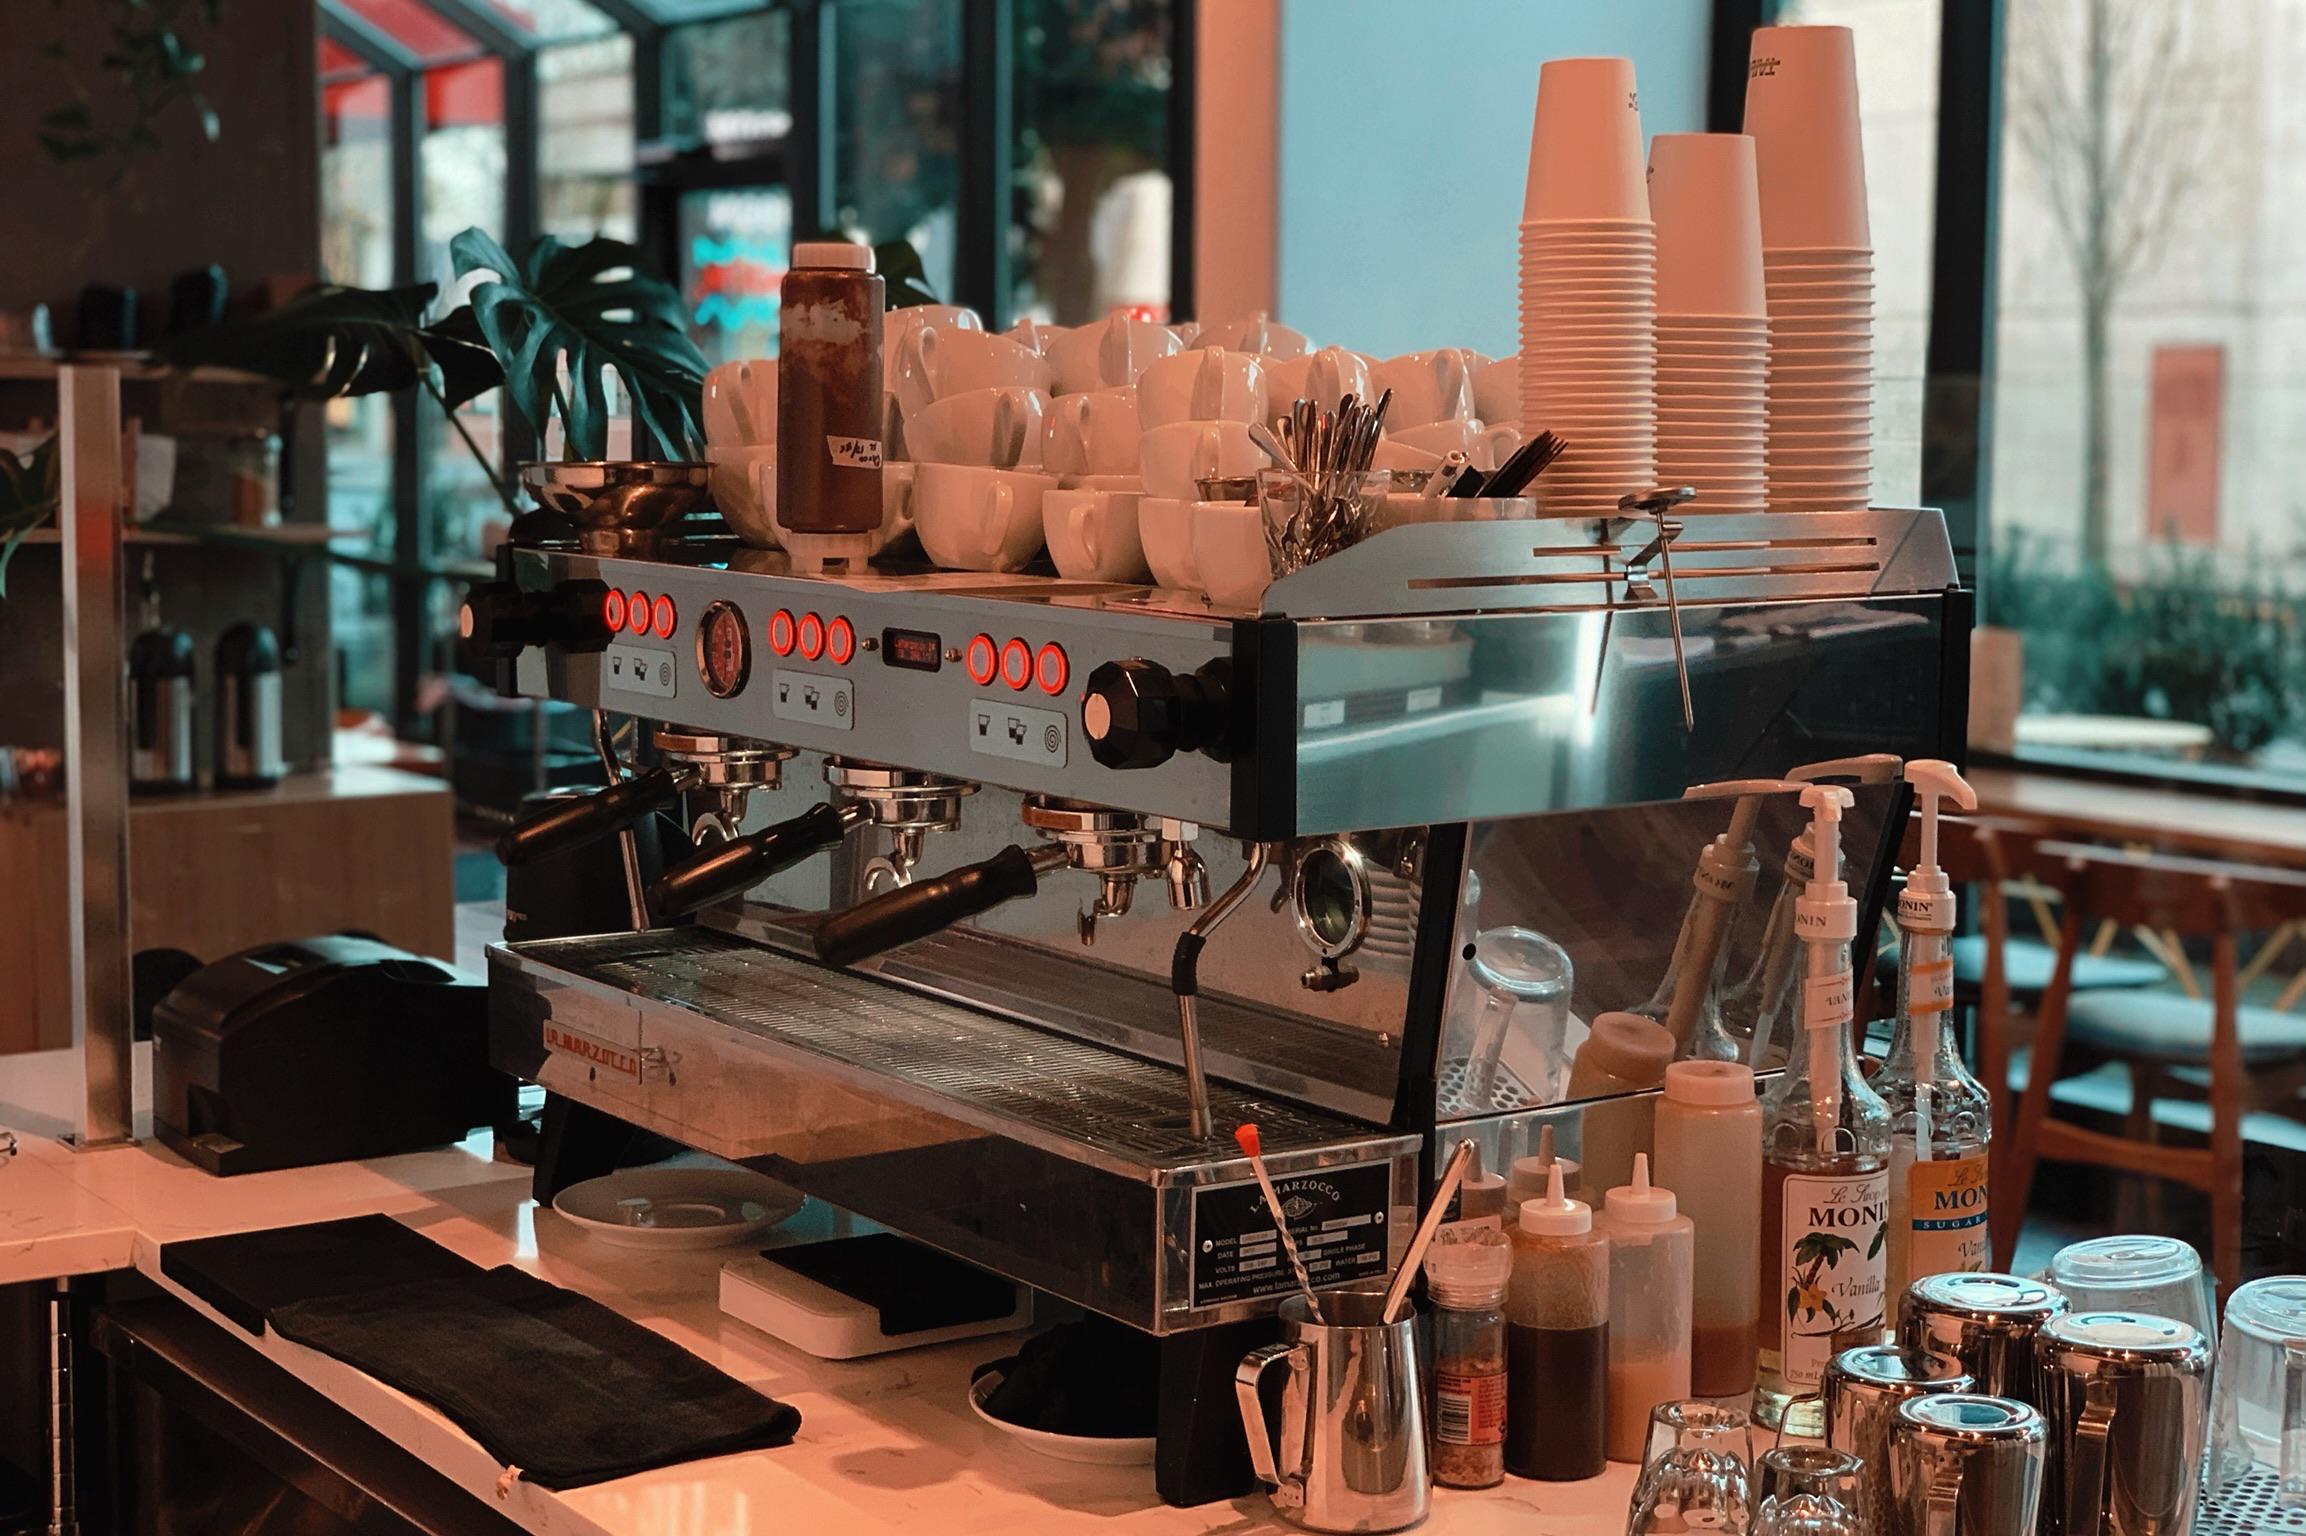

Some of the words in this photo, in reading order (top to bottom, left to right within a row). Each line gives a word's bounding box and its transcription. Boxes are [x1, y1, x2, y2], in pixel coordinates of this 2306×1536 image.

[1273, 1180, 1340, 1201] MARZOCCO
[1934, 1184, 1987, 1210] MON
[1923, 1215, 1981, 1229] SUGAR
[1217, 1251, 1234, 1260] DATE
[1215, 1264, 1236, 1275] VOLTS
[1831, 1274, 1880, 1297] Vanilla
